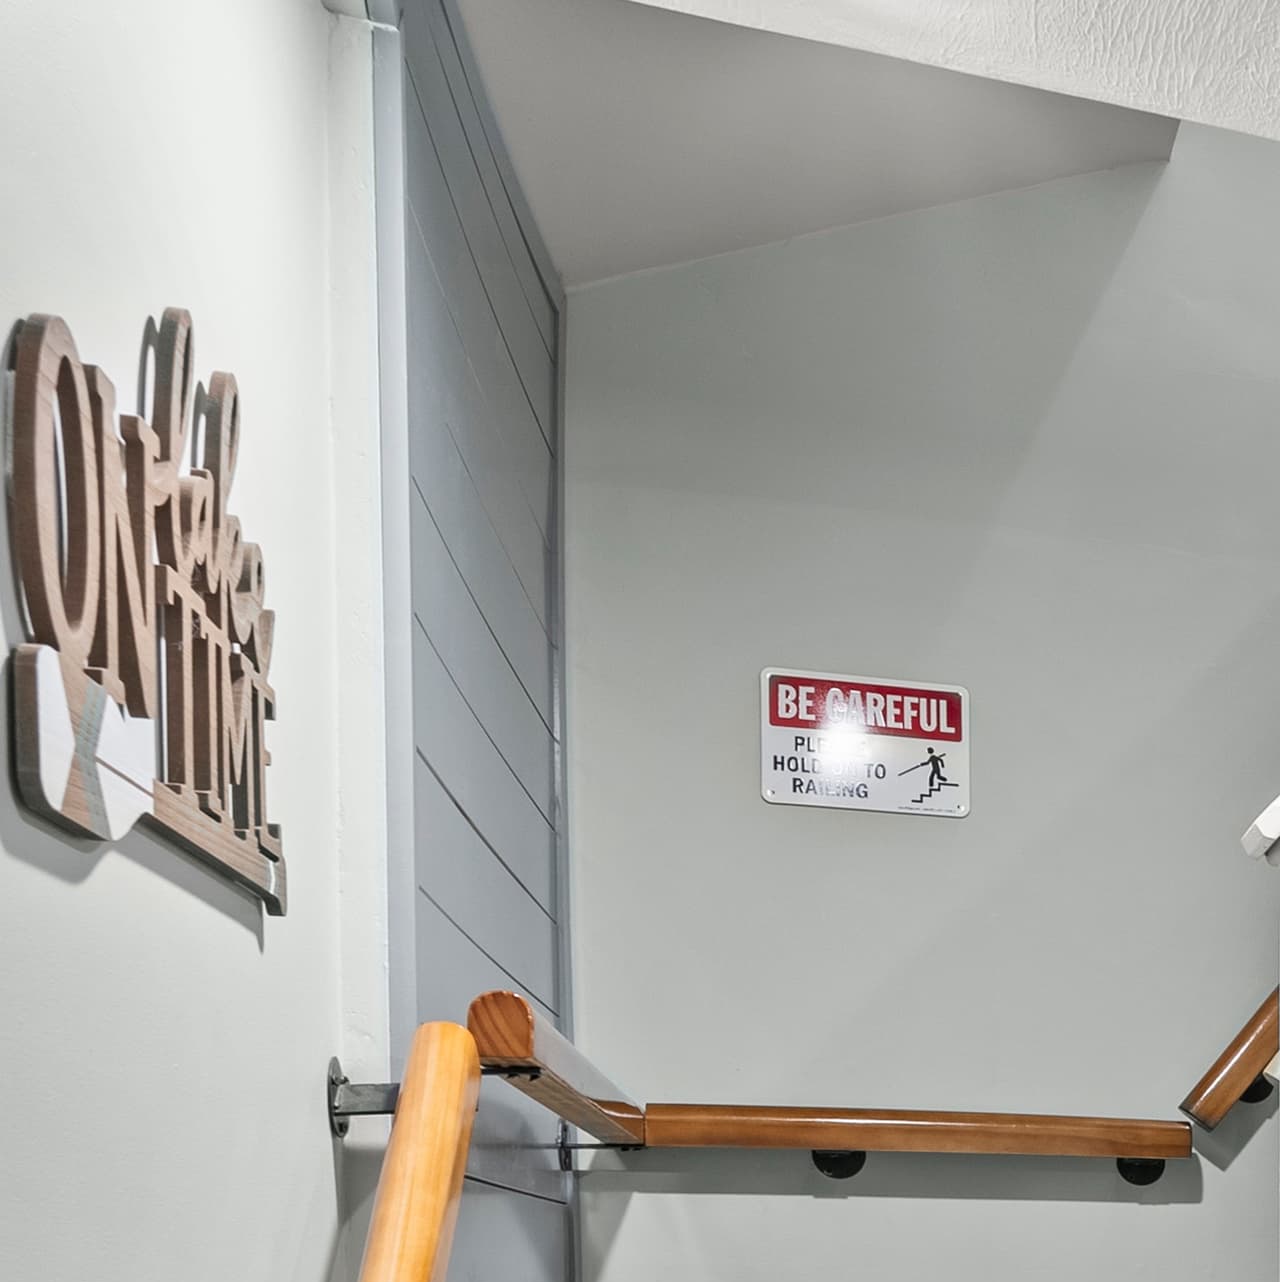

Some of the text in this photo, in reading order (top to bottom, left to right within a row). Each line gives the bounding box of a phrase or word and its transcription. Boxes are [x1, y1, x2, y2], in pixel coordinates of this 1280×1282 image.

[12, 312, 157, 718] ON
[154, 564, 280, 862] TIME
[777, 683, 956, 734] BE CAREFUL
[792, 778, 869, 799] RAILING
[865, 763, 887, 780] TO
